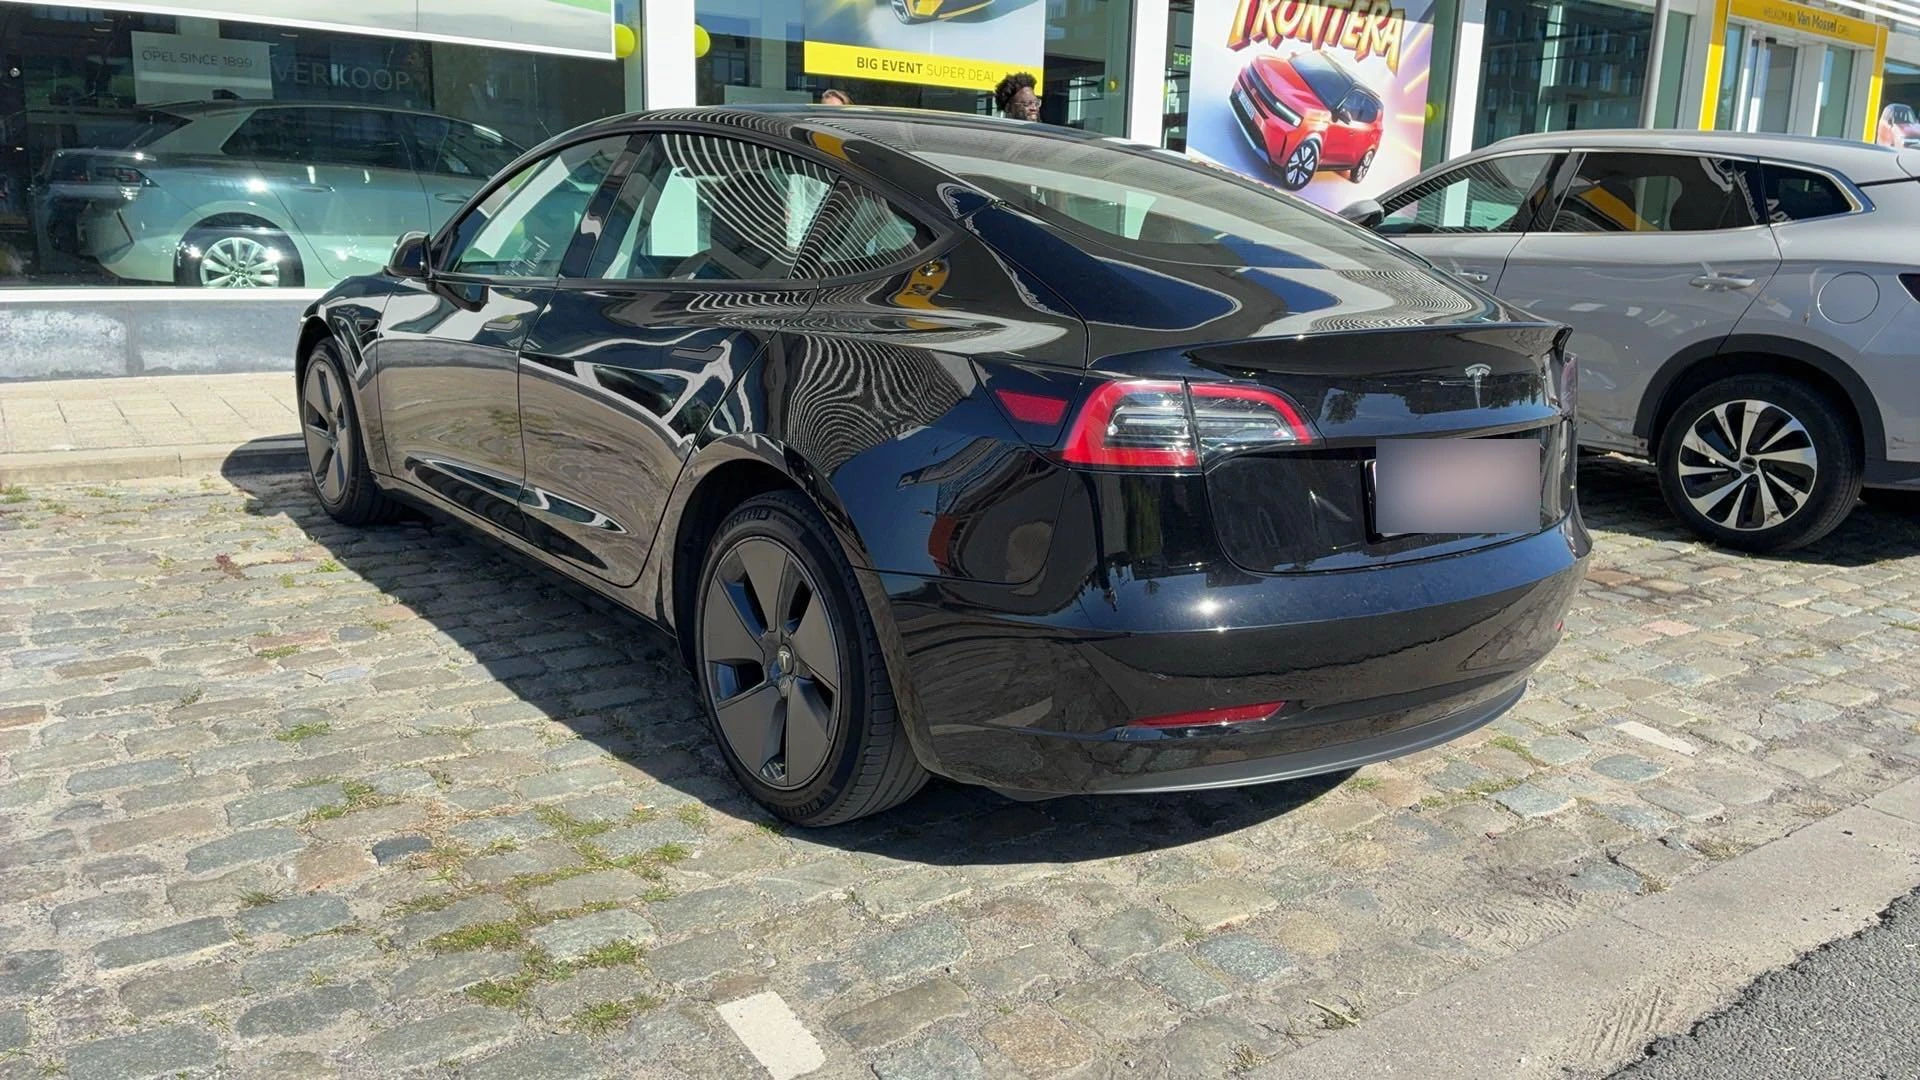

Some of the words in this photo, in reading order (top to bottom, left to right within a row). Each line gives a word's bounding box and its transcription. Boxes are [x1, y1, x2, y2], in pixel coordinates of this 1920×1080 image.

[1797, 10, 1811, 27] Van
[1812, 15, 1837, 33] Mossel
[142, 49, 177, 63] OPEL
[179, 52, 218, 66] SINCE
[220, 55, 254, 69] 1899
[856, 56, 878, 70] BIG
[882, 59, 923, 75] EVENT
[926, 63, 965, 80] SUPER
[968, 68, 998, 83] DEAL
[272, 59, 410, 91] VERKOOP
